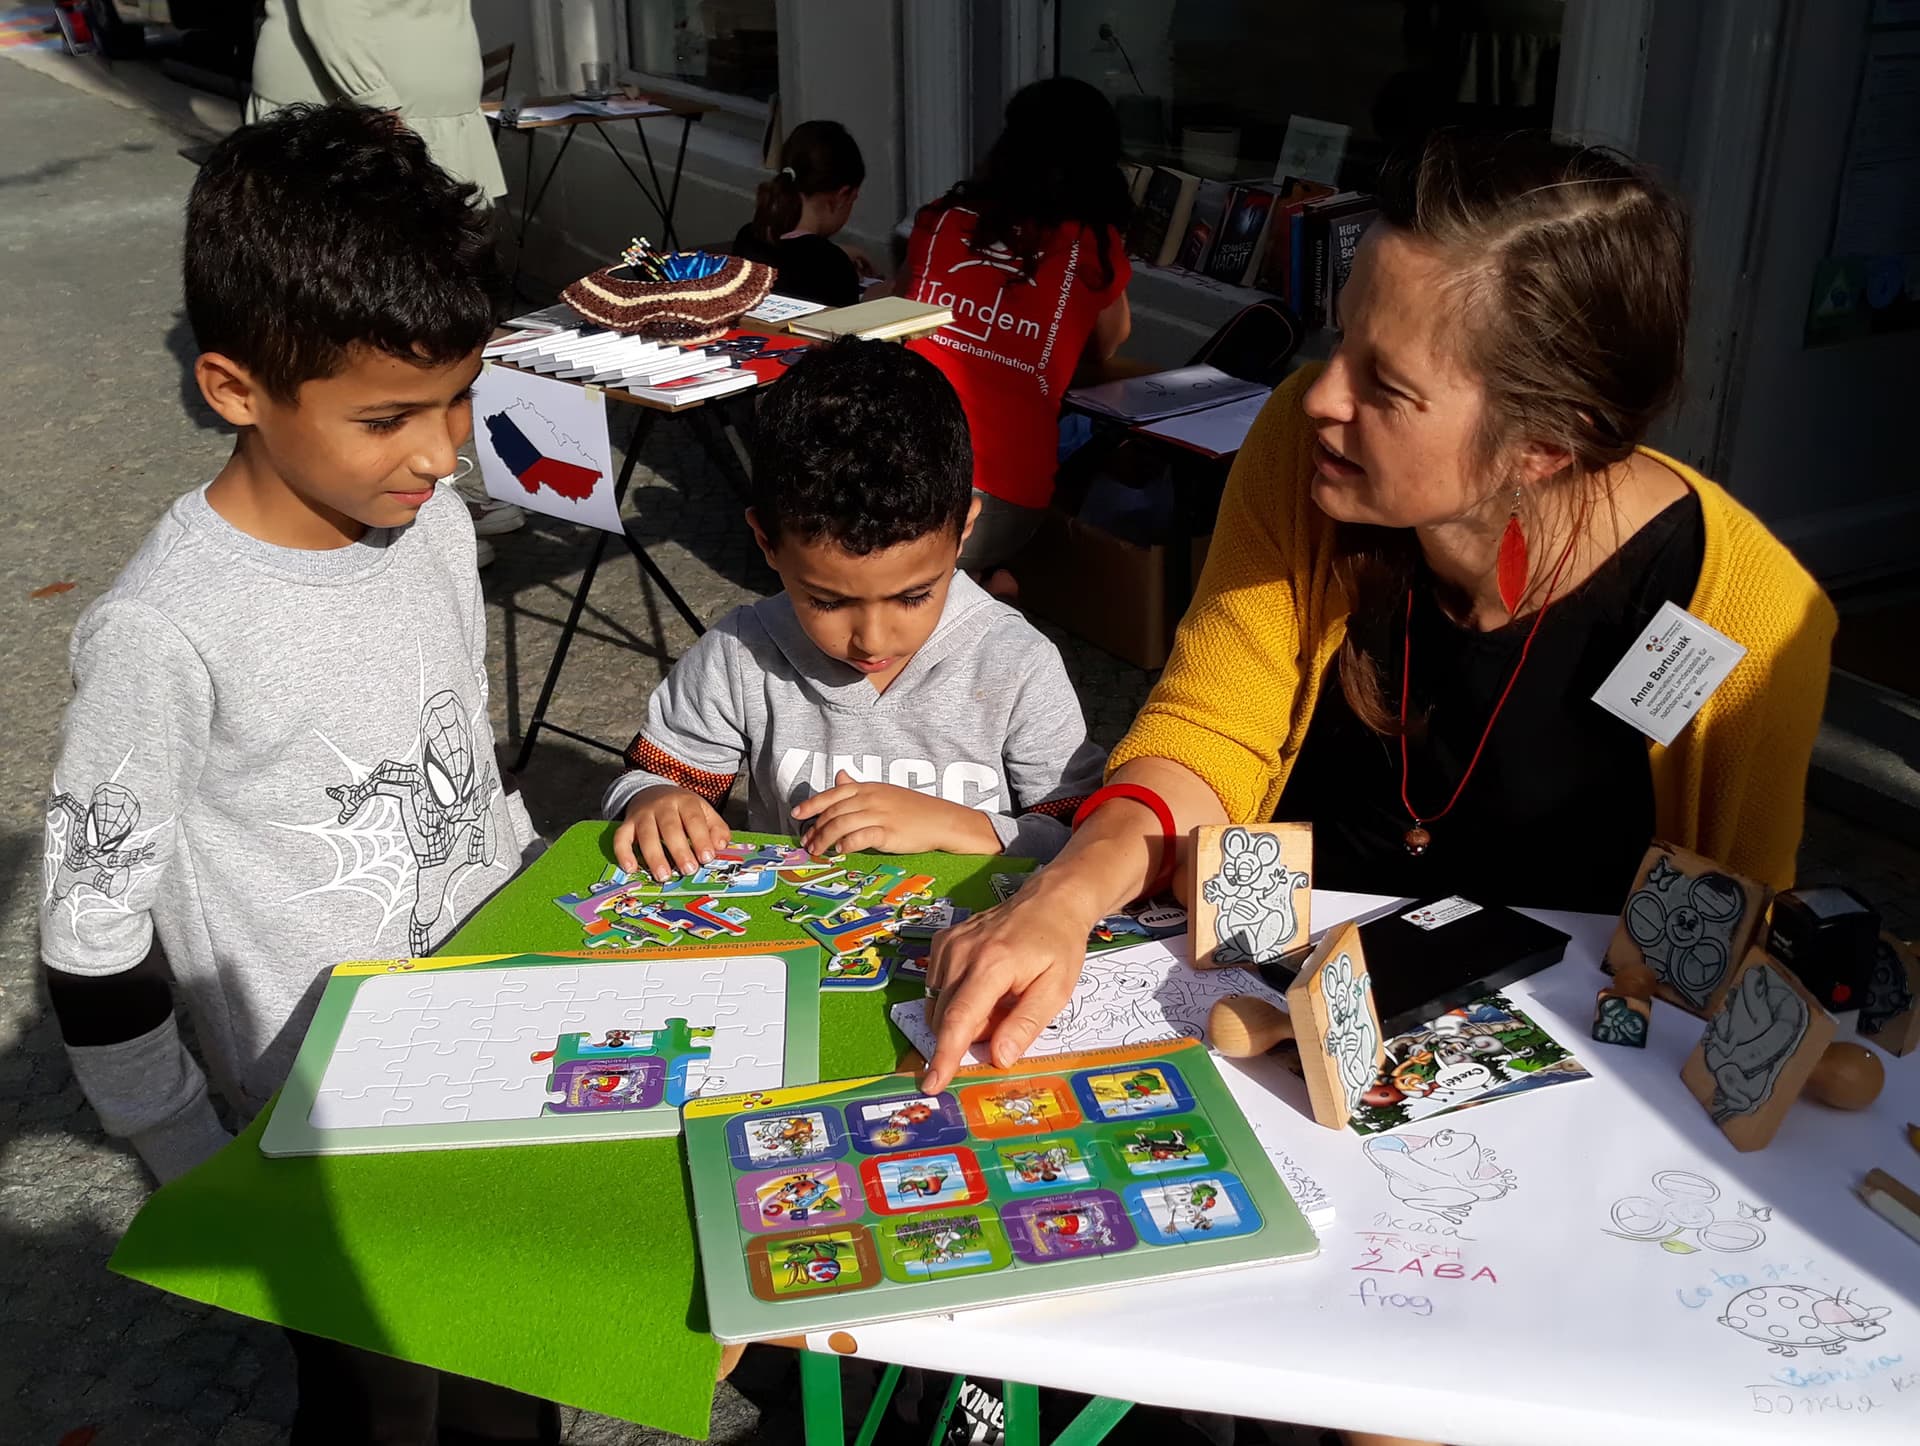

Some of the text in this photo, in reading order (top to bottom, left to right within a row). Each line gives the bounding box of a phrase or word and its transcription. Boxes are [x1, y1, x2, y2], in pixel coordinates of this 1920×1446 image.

[927, 281, 1041, 340] Tandem
[1630, 681, 1655, 707] Anne
[1649, 634, 1692, 681] Bartusiak
[1144, 911, 1185, 923] Hallo!
[780, 1166, 808, 1175] August
[763, 1204, 784, 1217] C
[789, 1208, 809, 1221] B
[1349, 1277, 1433, 1316] frog
